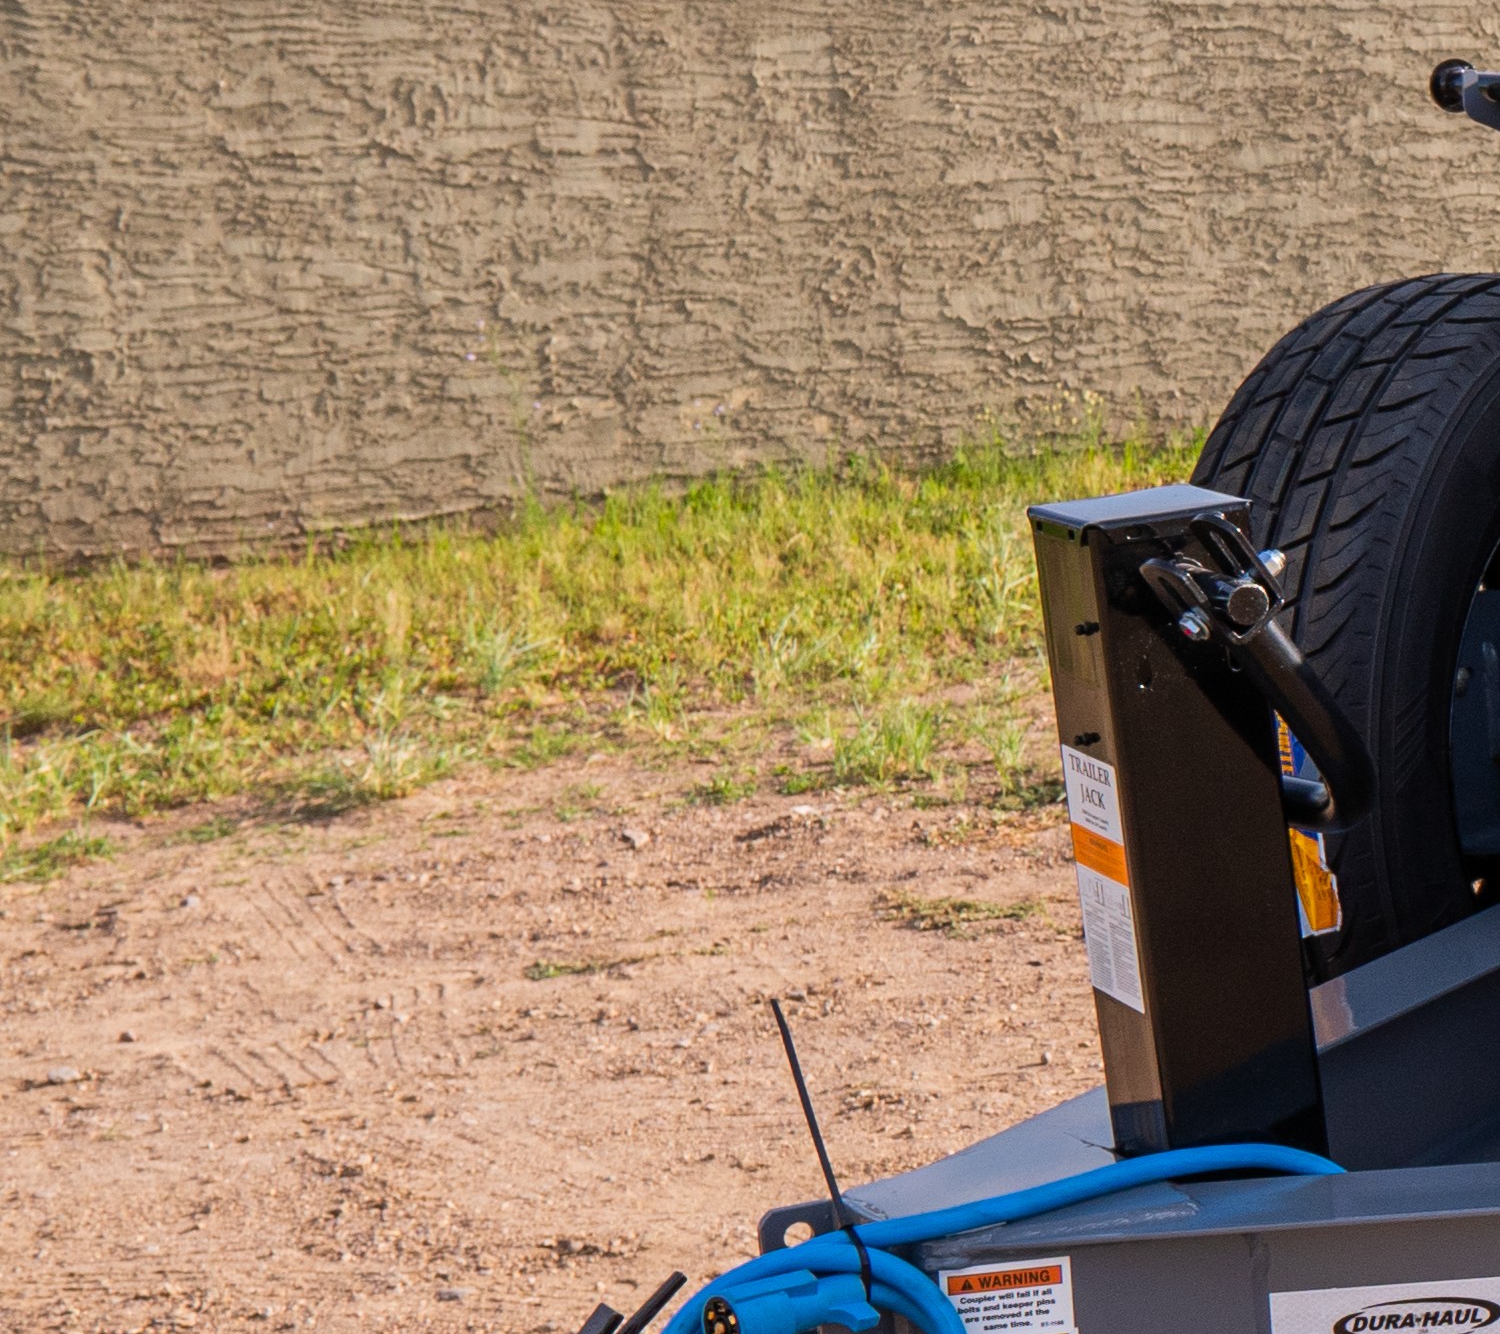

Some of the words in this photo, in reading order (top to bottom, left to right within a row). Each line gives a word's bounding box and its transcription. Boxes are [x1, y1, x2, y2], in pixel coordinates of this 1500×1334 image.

[1069, 753, 1111, 787] TRAILER
[1080, 783, 1105, 810] JACK
[978, 1269, 1050, 1289] WARNING
[960, 1294, 996, 1305] Coupler
[998, 1292, 1014, 1300] will
[983, 1303, 1000, 1312] and
[1002, 1300, 1034, 1311] keeper
[1036, 1298, 1056, 1308] pins
[982, 1310, 1022, 1321] removed
[1024, 1309, 1034, 1317] at
[1035, 1308, 1050, 1316] the
[1351, 1307, 1483, 1334] DURA-HAUL
[984, 1323, 1008, 1331] same
[1010, 1319, 1033, 1328] time.
